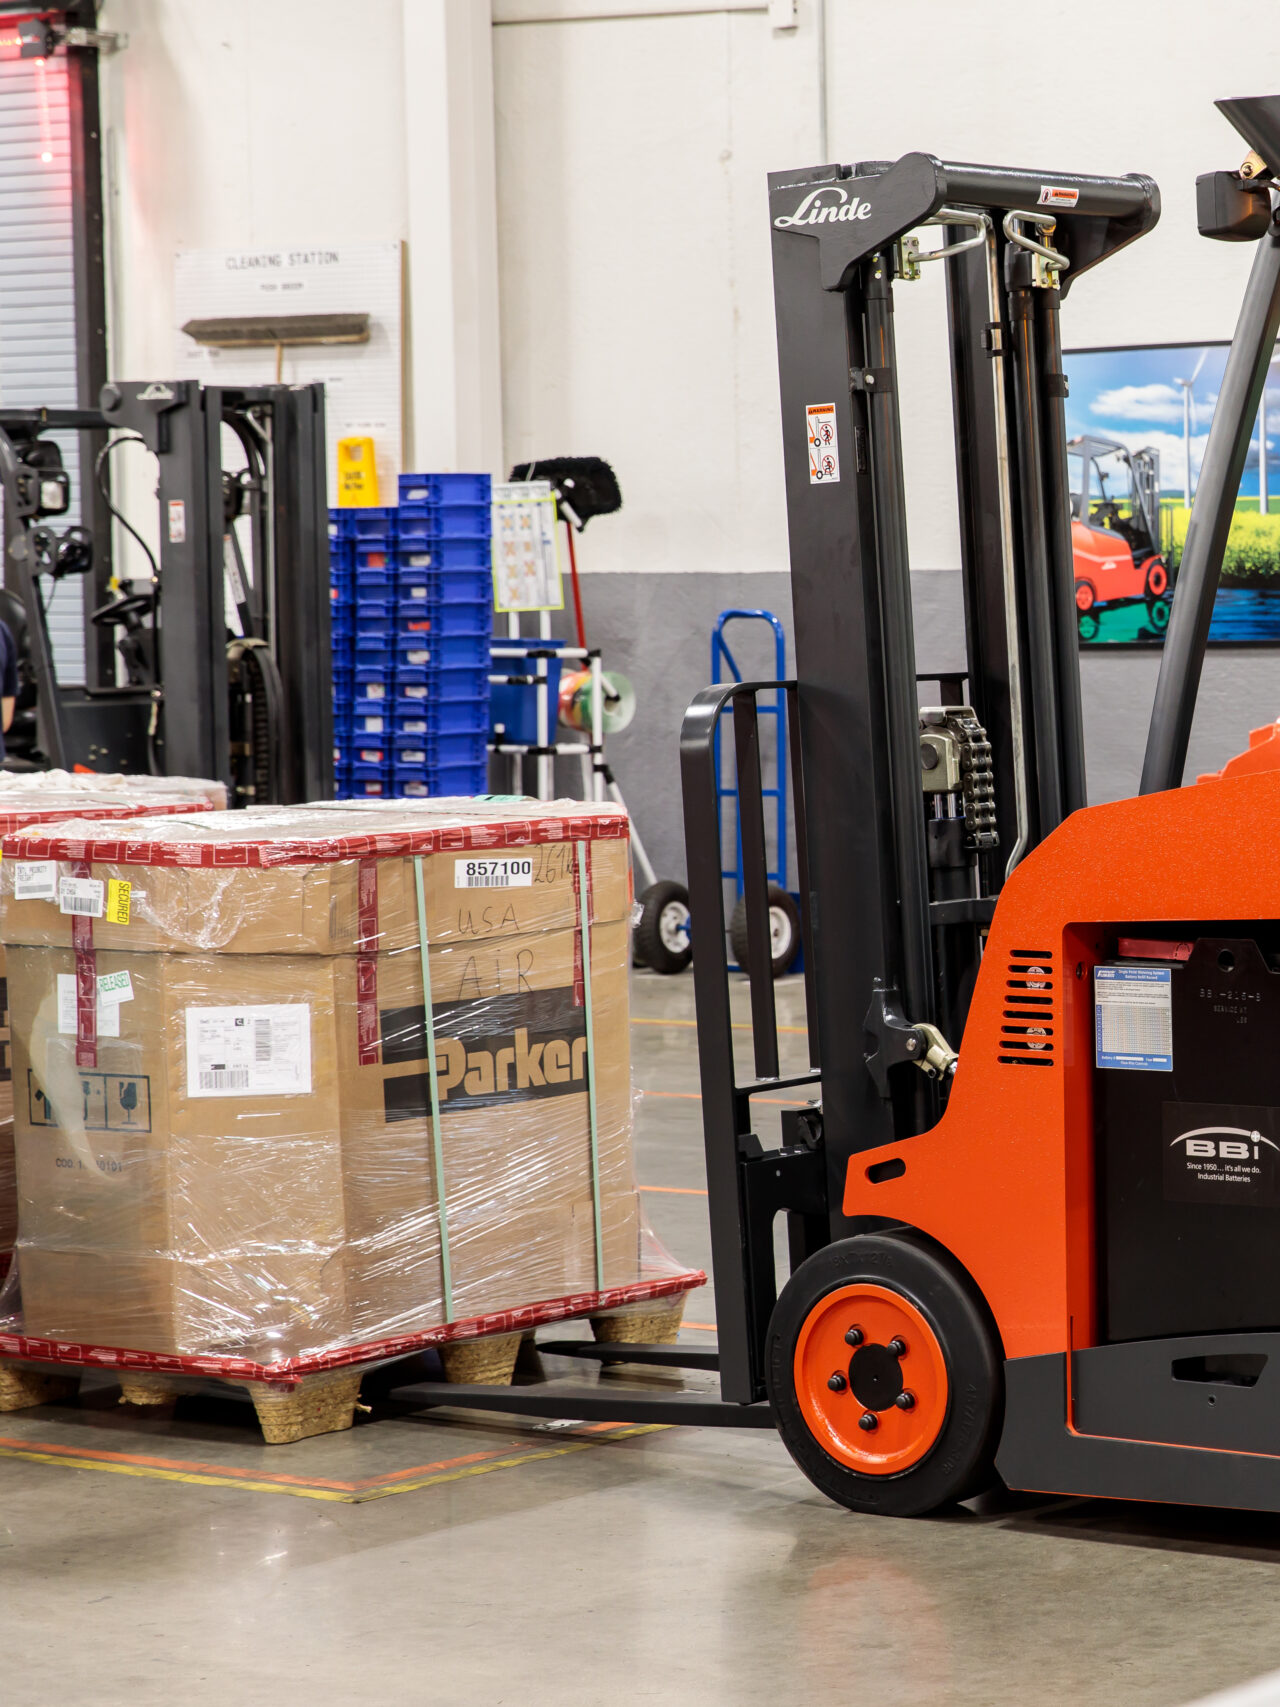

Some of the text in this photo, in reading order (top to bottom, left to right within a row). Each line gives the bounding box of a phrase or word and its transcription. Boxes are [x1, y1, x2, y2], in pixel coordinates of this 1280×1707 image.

[774, 187, 872, 227] Linde
[225, 251, 340, 270] CLEANING STATION
[466, 861, 531, 876] 857100
[117, 882, 130, 923] SECURED
[458, 903, 520, 935] USA
[458, 948, 534, 1000] AIR
[432, 1028, 588, 1101] Parker
[1186, 1162, 1202, 1170] Since
[1224, 1164, 1234, 1172] it's
[1233, 1165, 1242, 1173] all
[1251, 1166, 1262, 1174] do.
[1197, 1172, 1251, 1183] Industrial Batteries
